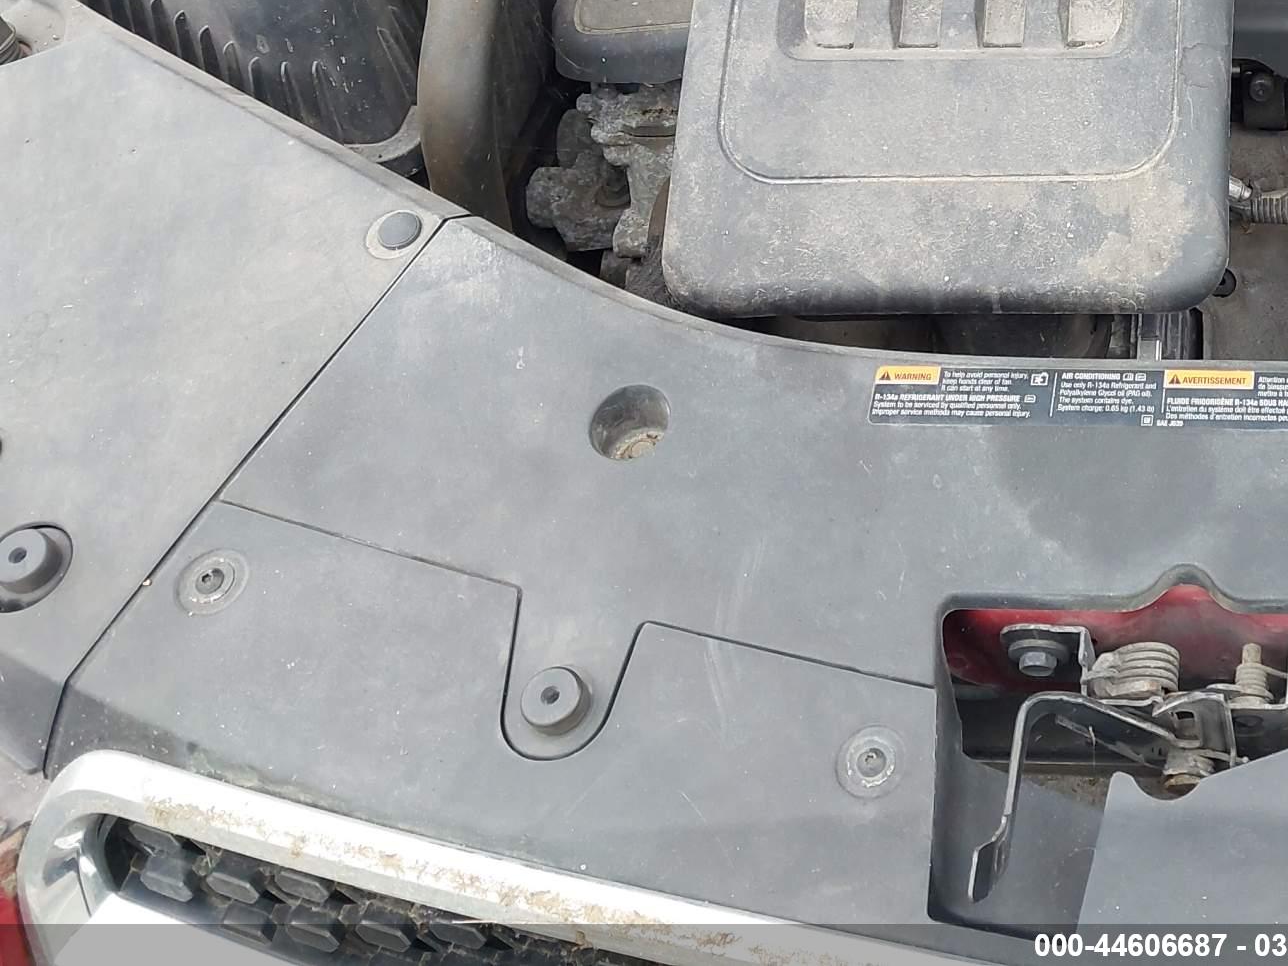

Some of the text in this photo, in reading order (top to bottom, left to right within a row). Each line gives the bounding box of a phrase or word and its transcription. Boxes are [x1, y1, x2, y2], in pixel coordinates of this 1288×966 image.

[895, 373, 932, 381] WARNING
[952, 371, 966, 379] help
[984, 372, 1010, 380] personal
[1074, 372, 1120, 380] CONDITIONING
[942, 378, 958, 386] keep
[1183, 376, 1247, 385] AVERTISSEMENT
[982, 386, 993, 394] any
[1073, 382, 1086, 390] only
[900, 393, 944, 401] REFRIGERANT
[968, 394, 986, 402] HIGH
[986, 394, 1020, 402] PRESSURE
[1072, 397, 1093, 405] system
[1120, 398, 1134, 406] dye.
[1166, 396, 1189, 405] FLUIDE
[1190, 397, 1233, 405] FRIGORIGÈNE
[1234, 397, 1258, 406] R-134a
[1259, 398, 1277, 406] SOUS
[873, 401, 896, 409] System
[949, 402, 975, 410] qualified
[976, 402, 1006, 410] personnel
[1007, 402, 1021, 410] only.
[1081, 405, 1104, 413] charge:
[872, 409, 900, 417] Improper
[984, 410, 1012, 418] personal
[1012, 410, 1030, 419] injury.
